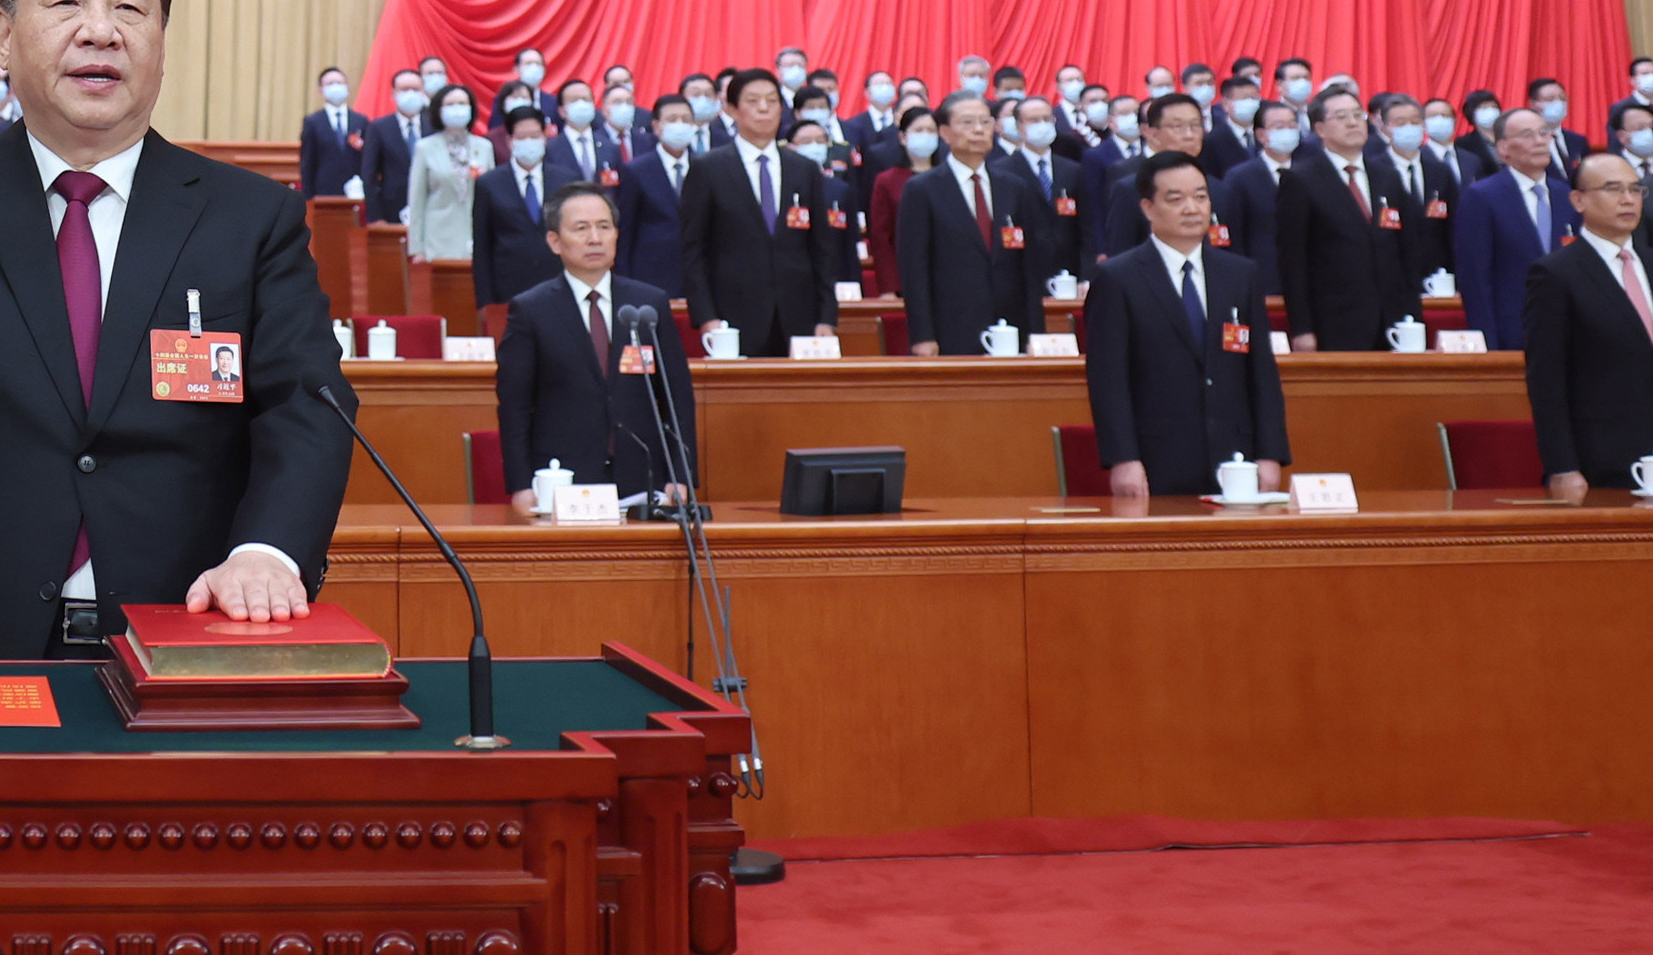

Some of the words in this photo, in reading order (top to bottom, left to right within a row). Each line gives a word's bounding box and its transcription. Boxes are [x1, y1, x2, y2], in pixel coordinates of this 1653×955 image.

[156, 362, 187, 374] 出席证
[187, 384, 210, 393] 0642
